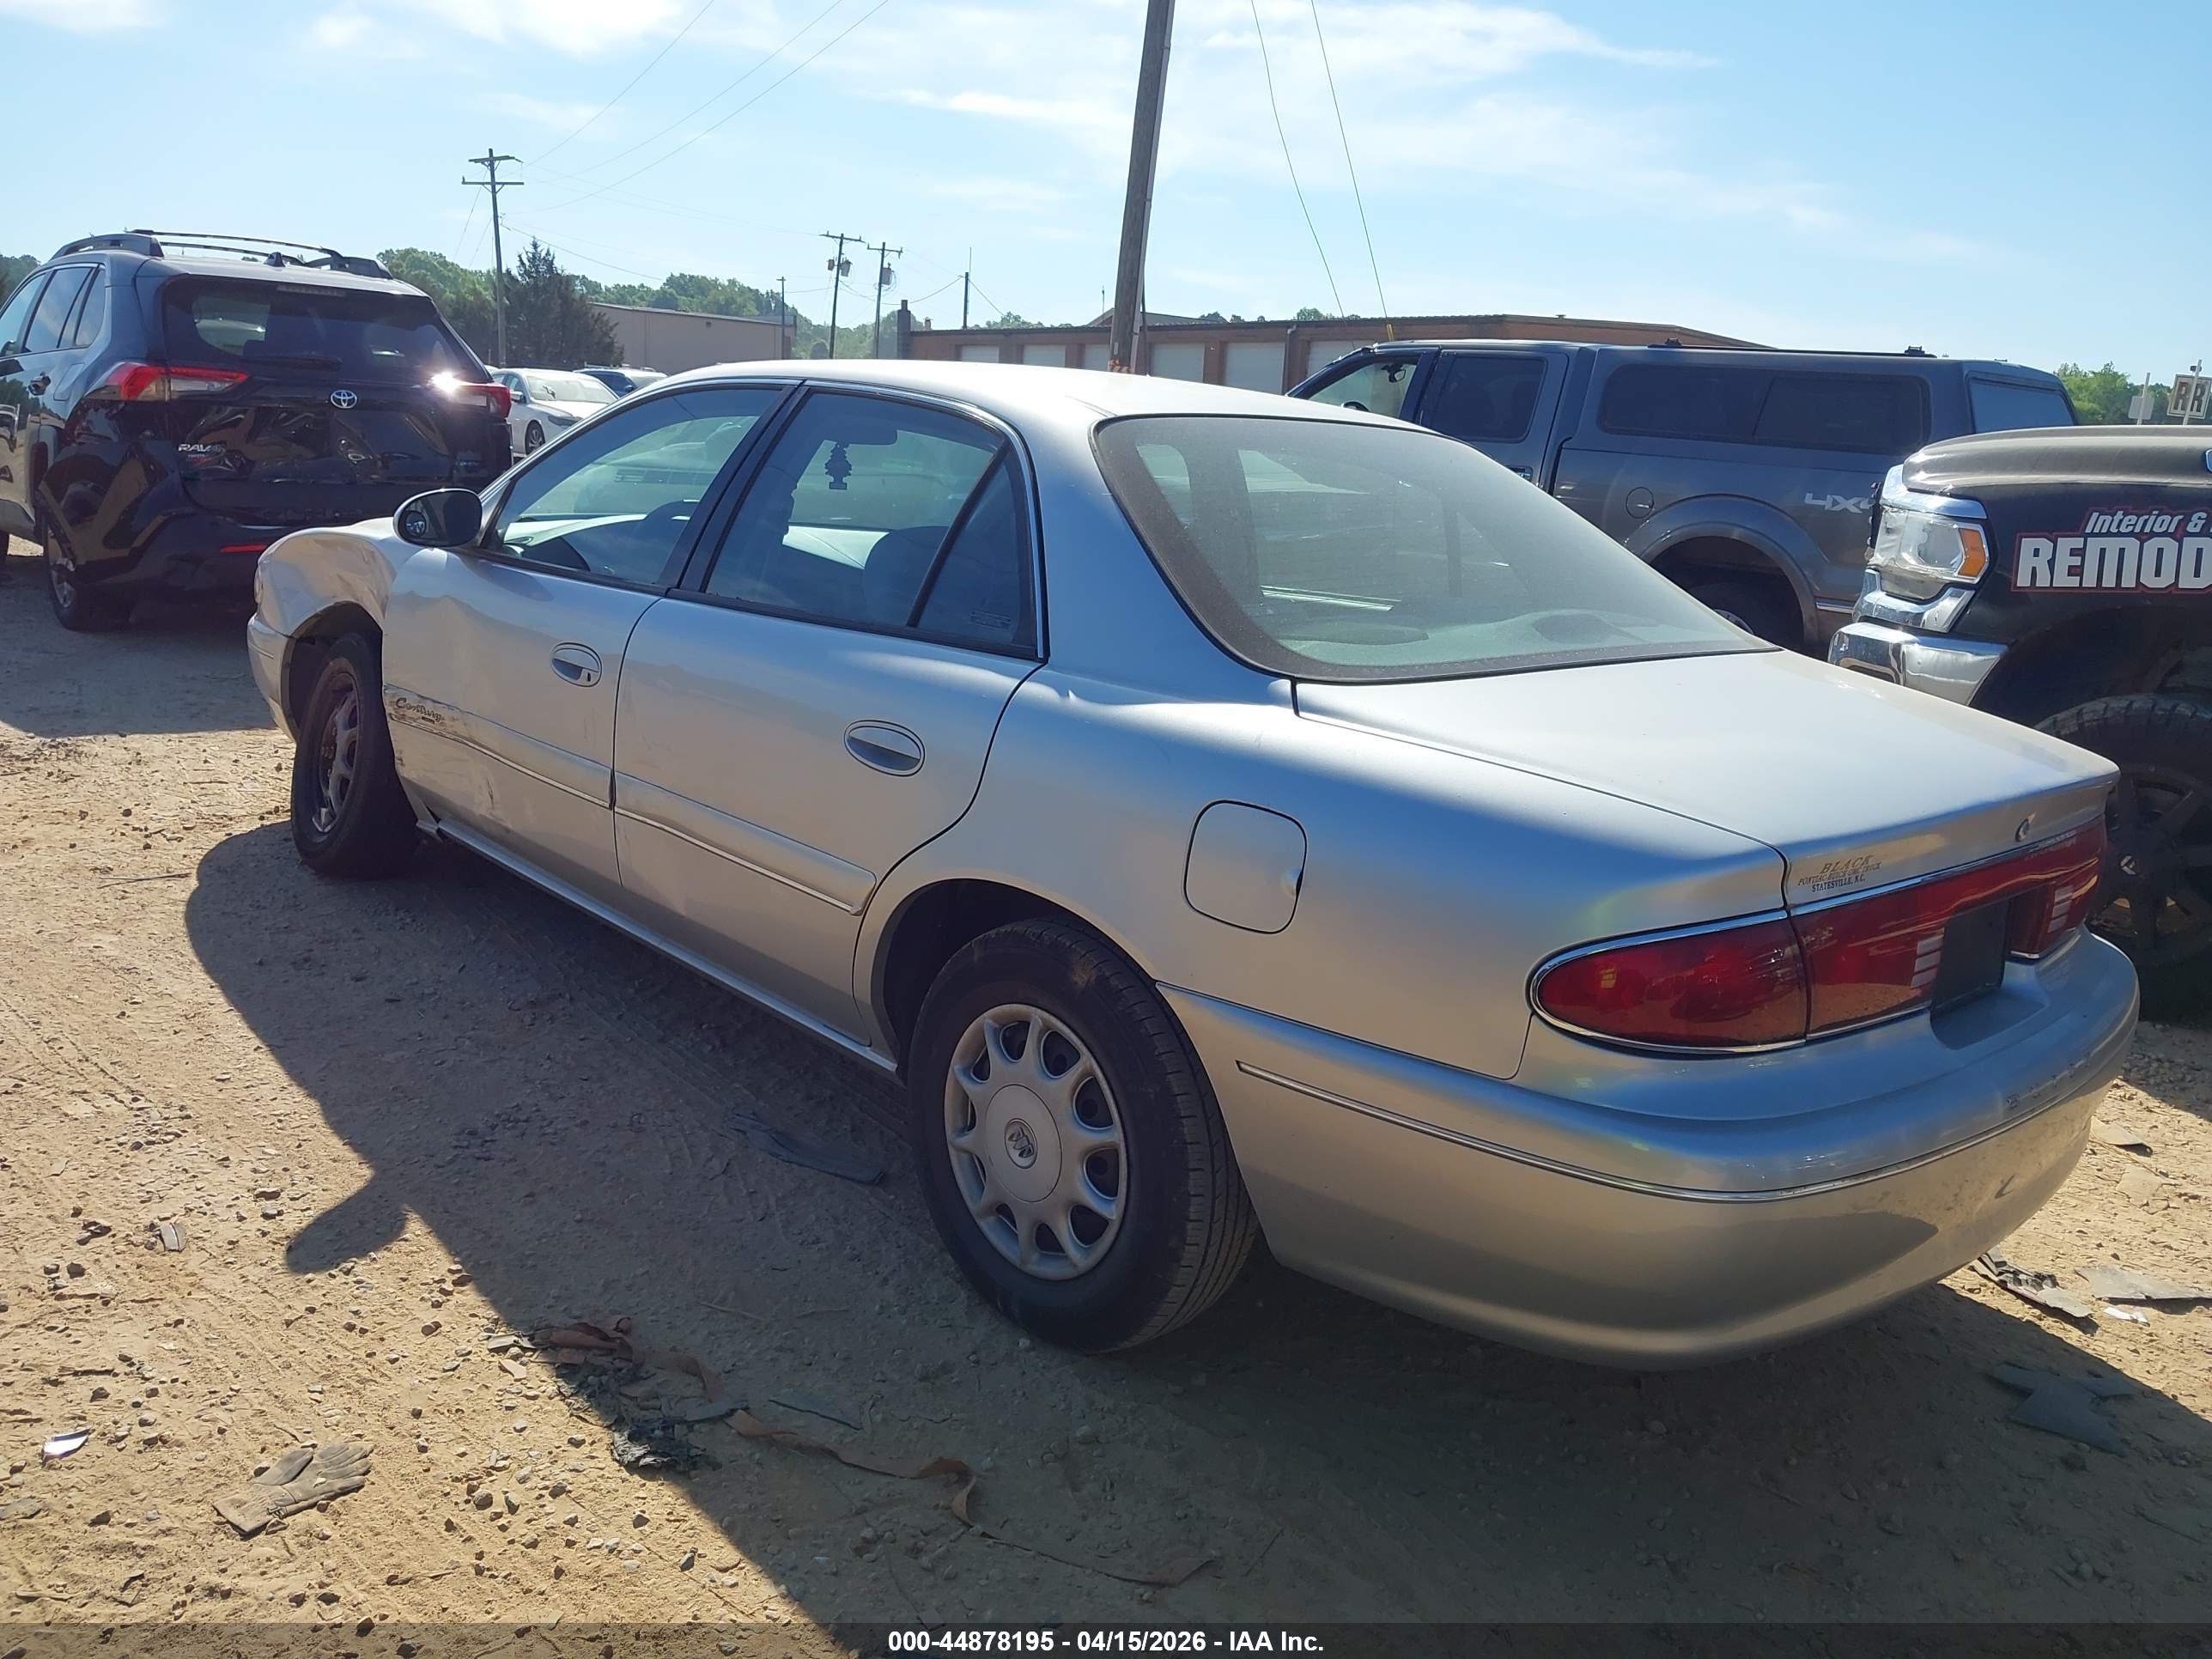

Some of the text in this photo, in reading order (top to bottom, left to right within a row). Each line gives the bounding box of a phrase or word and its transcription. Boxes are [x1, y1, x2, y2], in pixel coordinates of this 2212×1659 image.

[2085, 510, 2185, 533] Interior
[2186, 512, 2207, 533] &
[2016, 537, 2212, 589] REMOD
[395, 696, 442, 723] Century
[1820, 854, 1874, 874] BLACK
